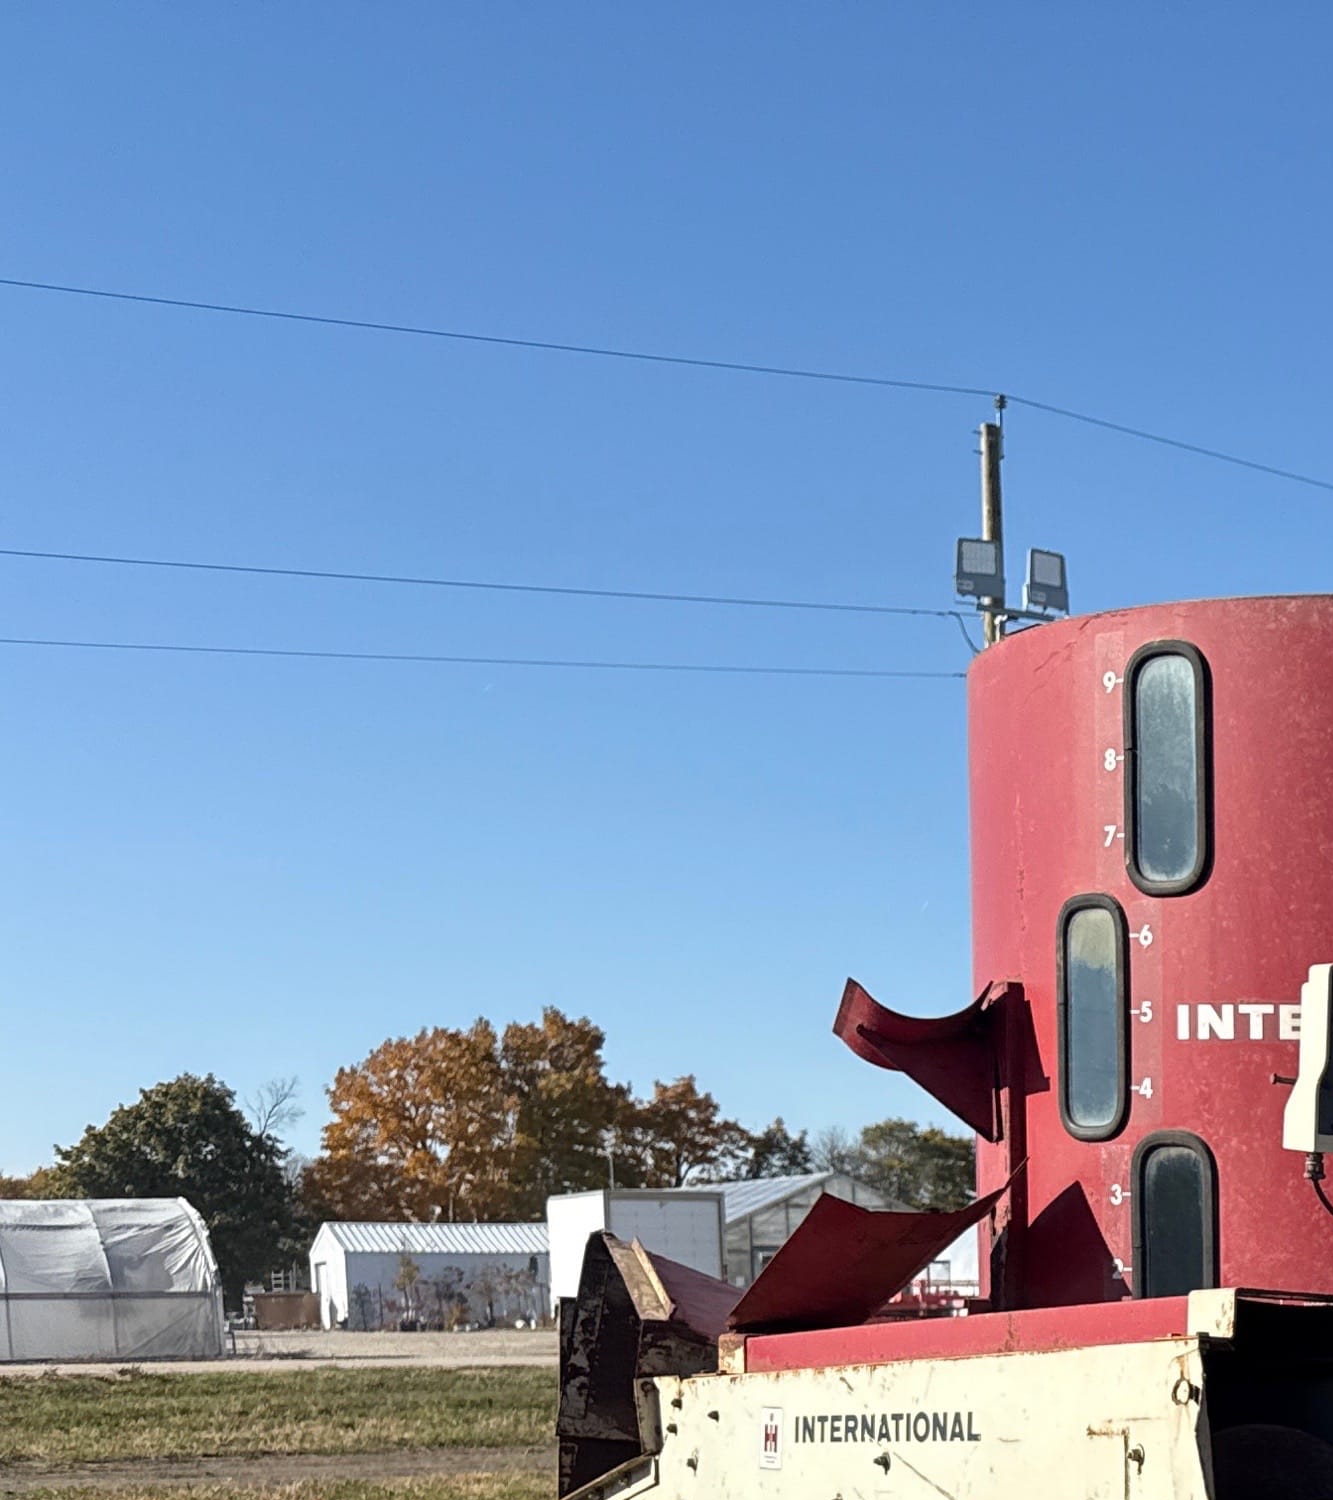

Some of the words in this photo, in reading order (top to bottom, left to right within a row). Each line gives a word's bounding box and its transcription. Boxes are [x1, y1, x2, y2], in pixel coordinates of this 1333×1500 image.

[1102, 670, 1117, 694] 9
[1103, 747, 1117, 772] 8
[1103, 825, 1117, 847] 7
[1138, 924, 1153, 949] 6
[1139, 1000, 1153, 1023] 5
[1138, 1077, 1153, 1099] 4
[1110, 1183, 1123, 1206] 3
[794, 1411, 982, 1443] INTERNATIONAL
